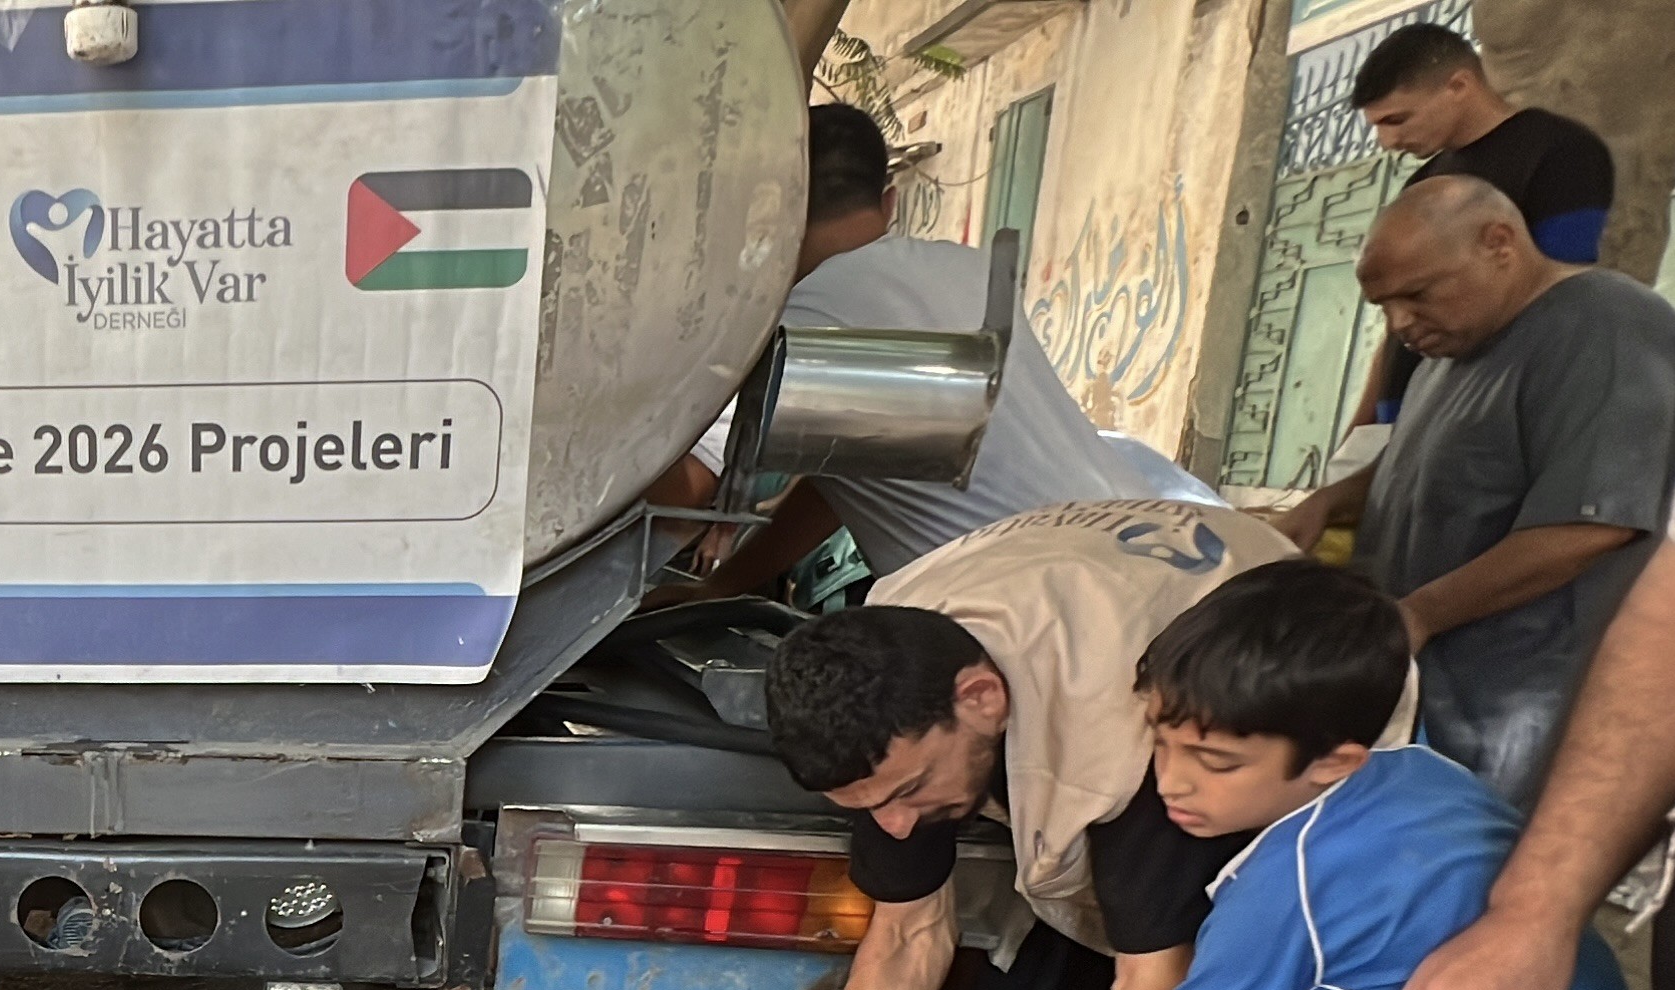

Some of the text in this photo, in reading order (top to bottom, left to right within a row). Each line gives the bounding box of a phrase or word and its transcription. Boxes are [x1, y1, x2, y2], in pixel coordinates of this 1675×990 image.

[108, 206, 294, 267] Hayatta
[63, 254, 267, 323] İyilik Var
[93, 307, 187, 330] DERNEĞİ
[32, 422, 170, 475] 2026
[190, 417, 454, 485] Projeleri
